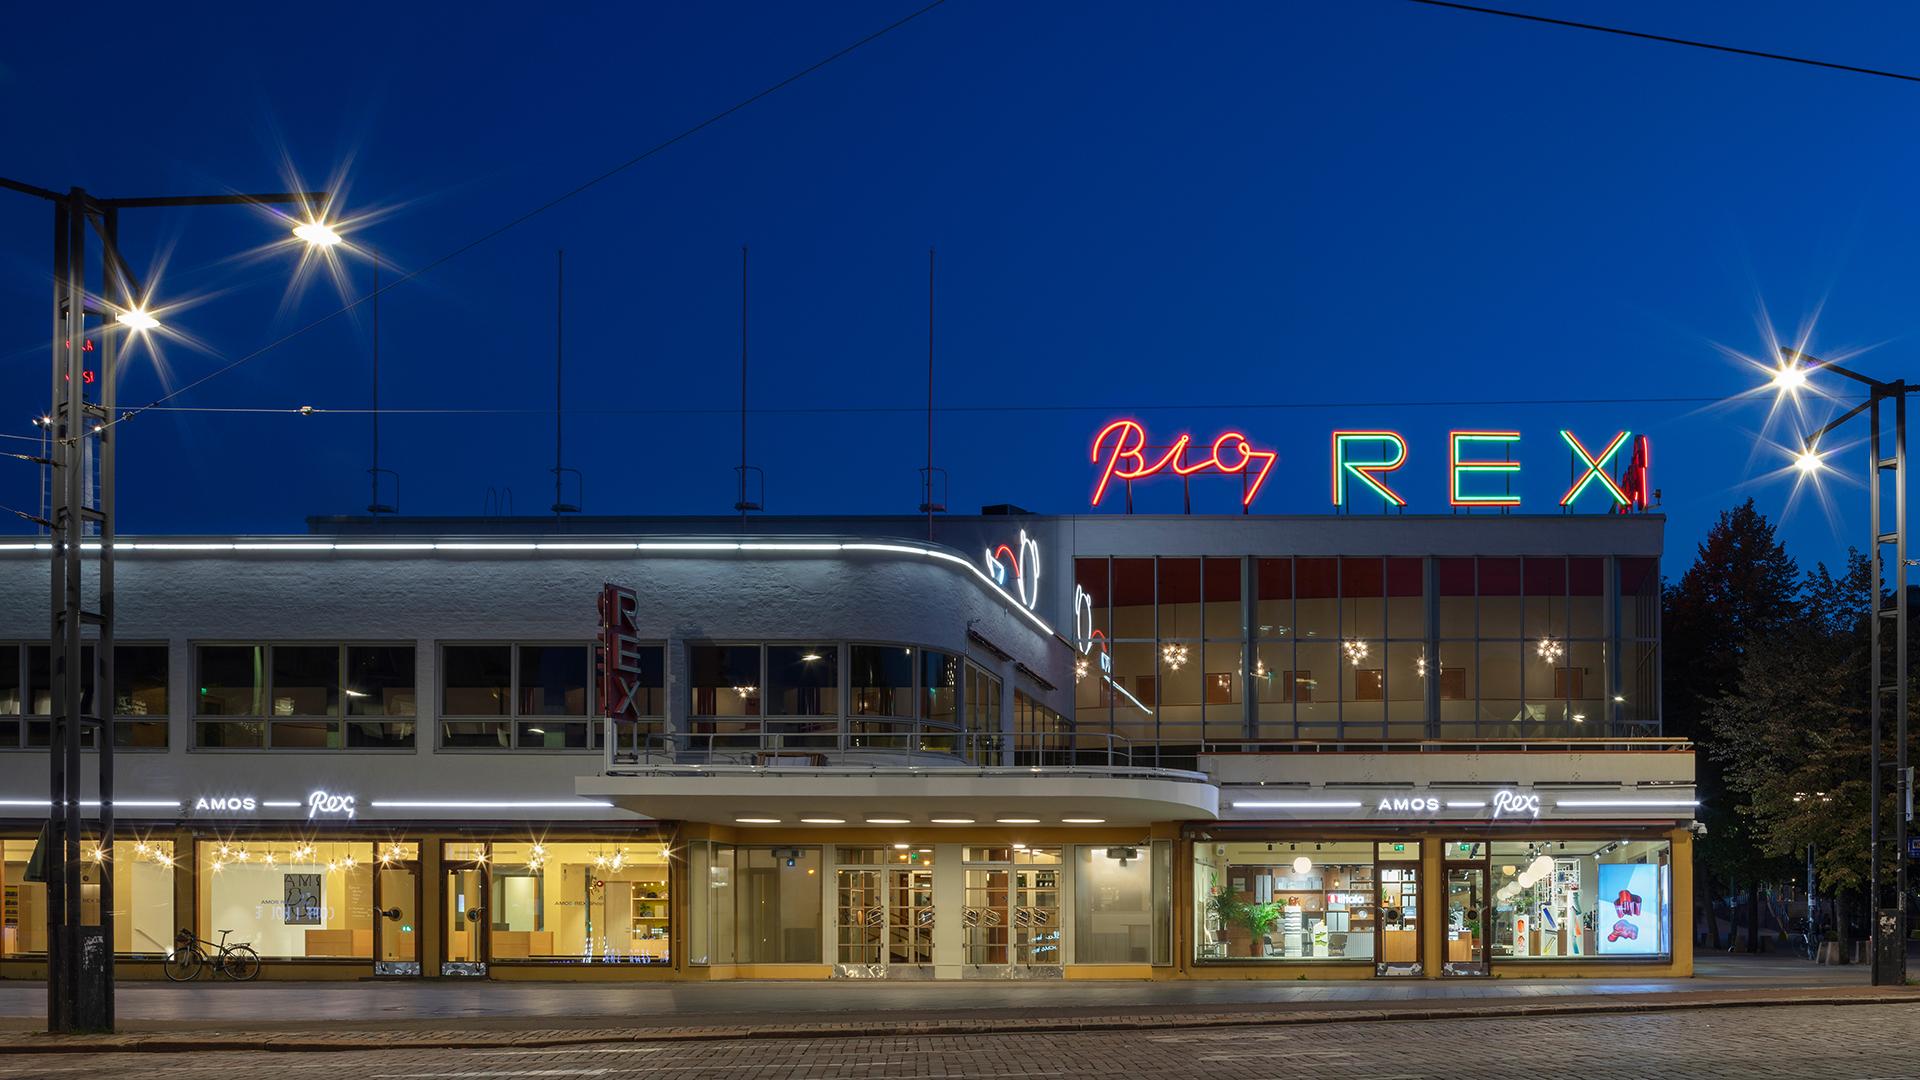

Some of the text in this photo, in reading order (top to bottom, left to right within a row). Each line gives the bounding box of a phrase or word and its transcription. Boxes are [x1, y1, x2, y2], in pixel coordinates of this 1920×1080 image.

[1092, 420, 1632, 506] Bio REX
[612, 590, 641, 717] REX
[196, 790, 354, 819] AMOS Rex
[1378, 790, 1540, 819] AMOS Rex
